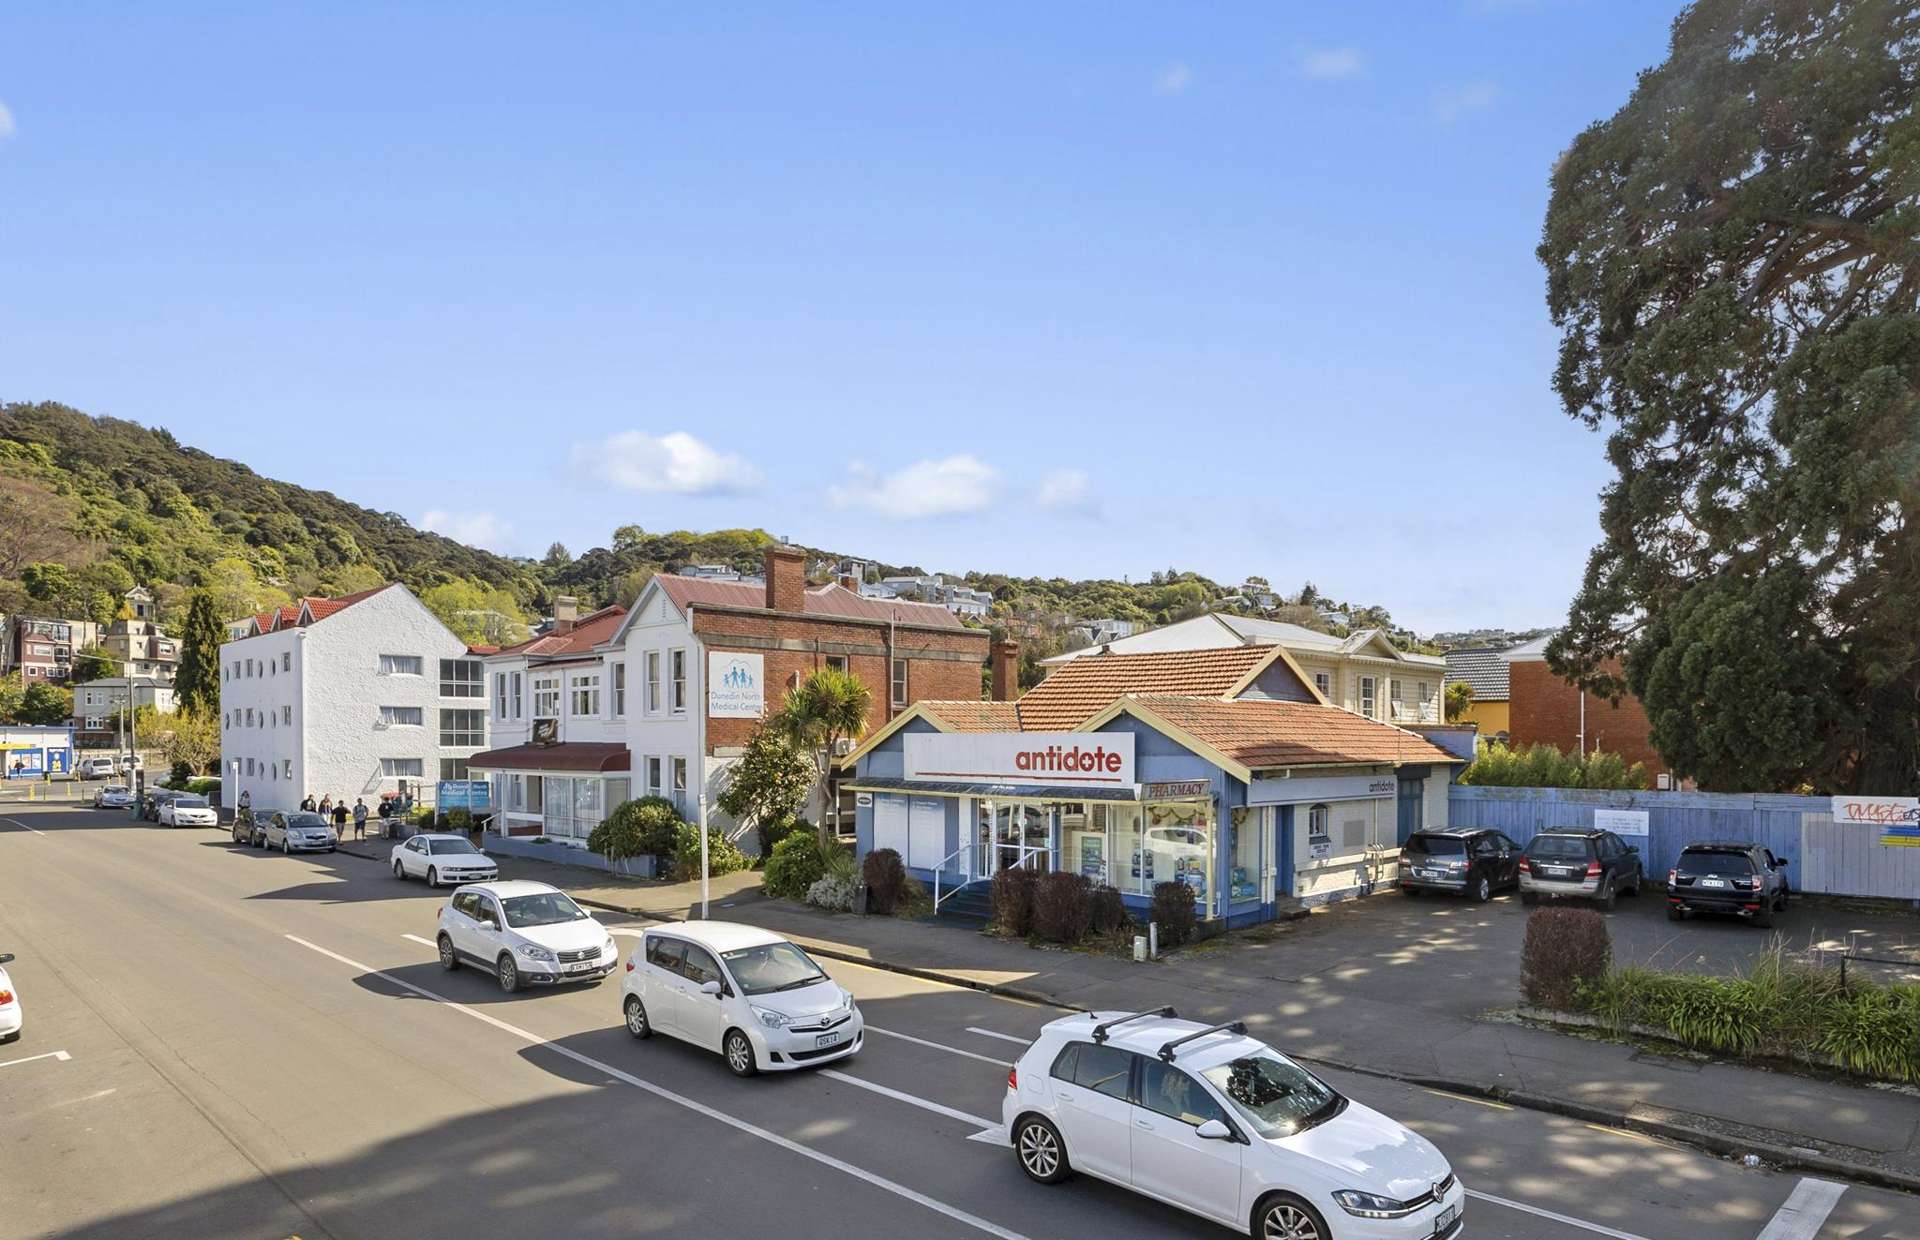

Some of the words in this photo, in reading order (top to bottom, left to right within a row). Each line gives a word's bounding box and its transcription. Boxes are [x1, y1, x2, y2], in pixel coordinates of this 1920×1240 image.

[711, 691, 739, 700] Dunedin
[742, 692, 761, 700] North
[1016, 746, 1122, 772] antidote
[1148, 784, 1204, 797] PHARMACY
[1369, 780, 1394, 792] antidote
